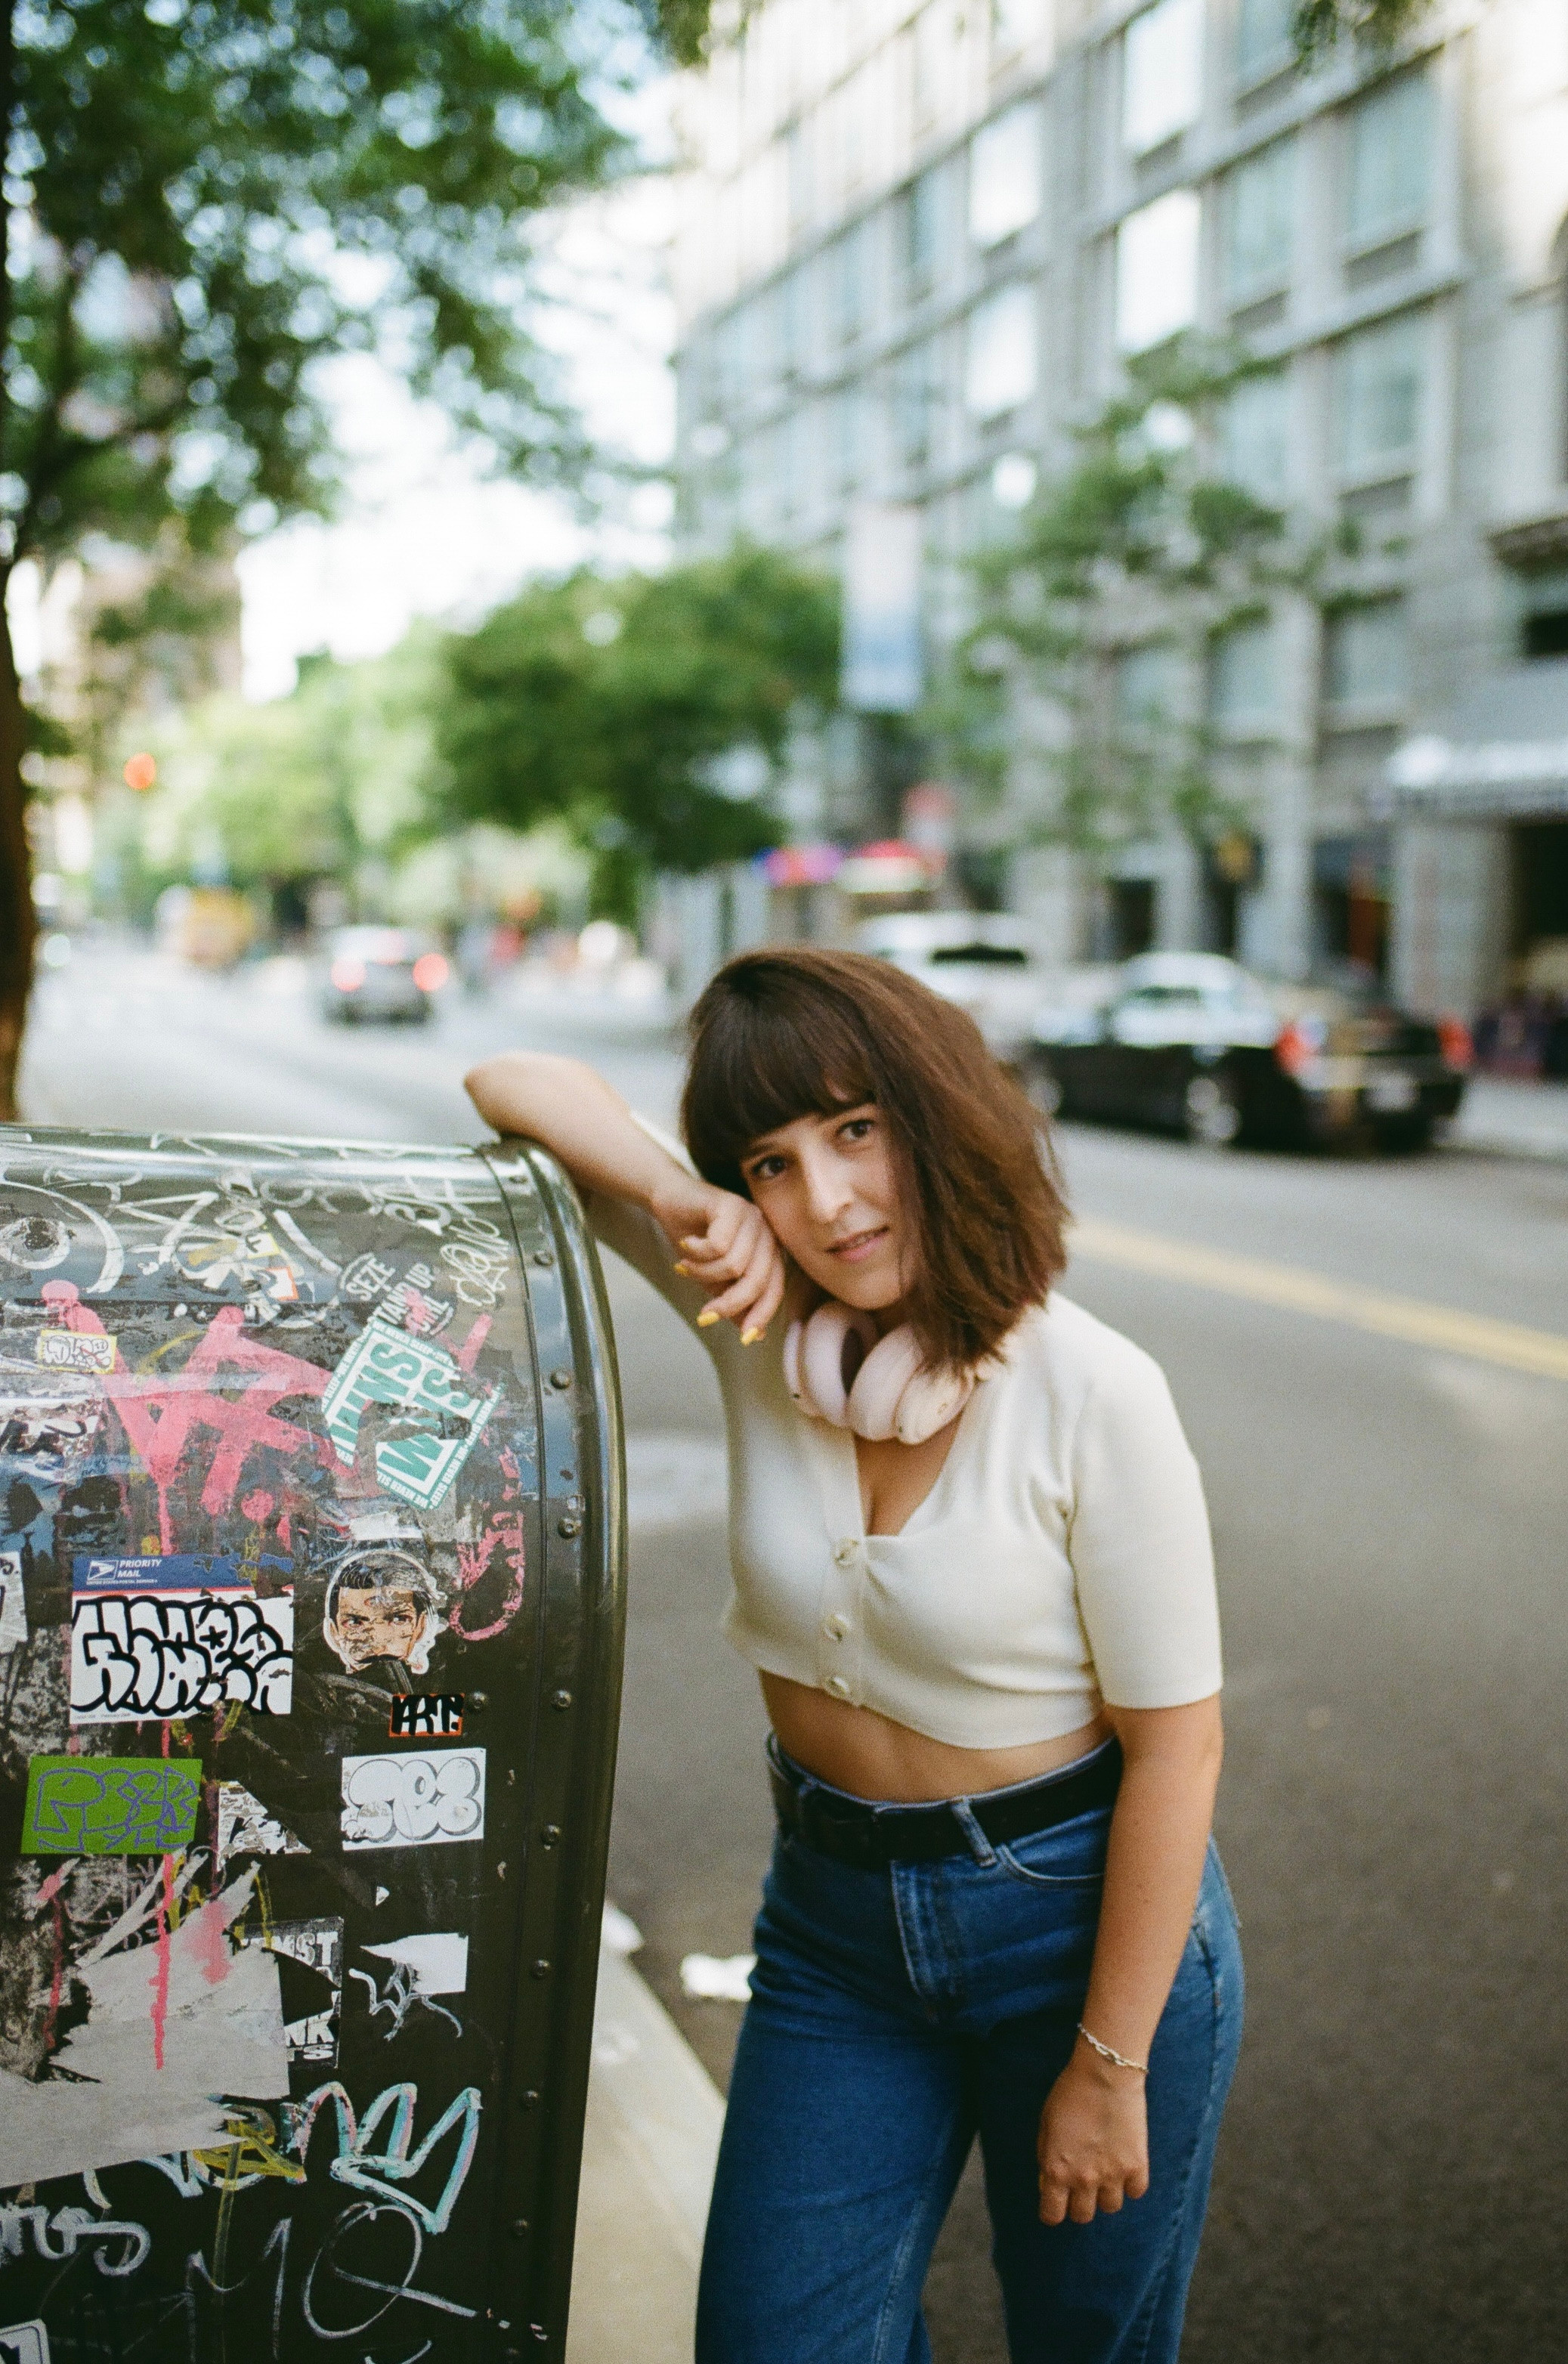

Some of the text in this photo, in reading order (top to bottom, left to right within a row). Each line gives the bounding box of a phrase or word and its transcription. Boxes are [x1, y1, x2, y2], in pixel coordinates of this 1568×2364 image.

[368, 1263, 435, 1325] TAND UP
[119, 1559, 162, 1567] PRIORITY
